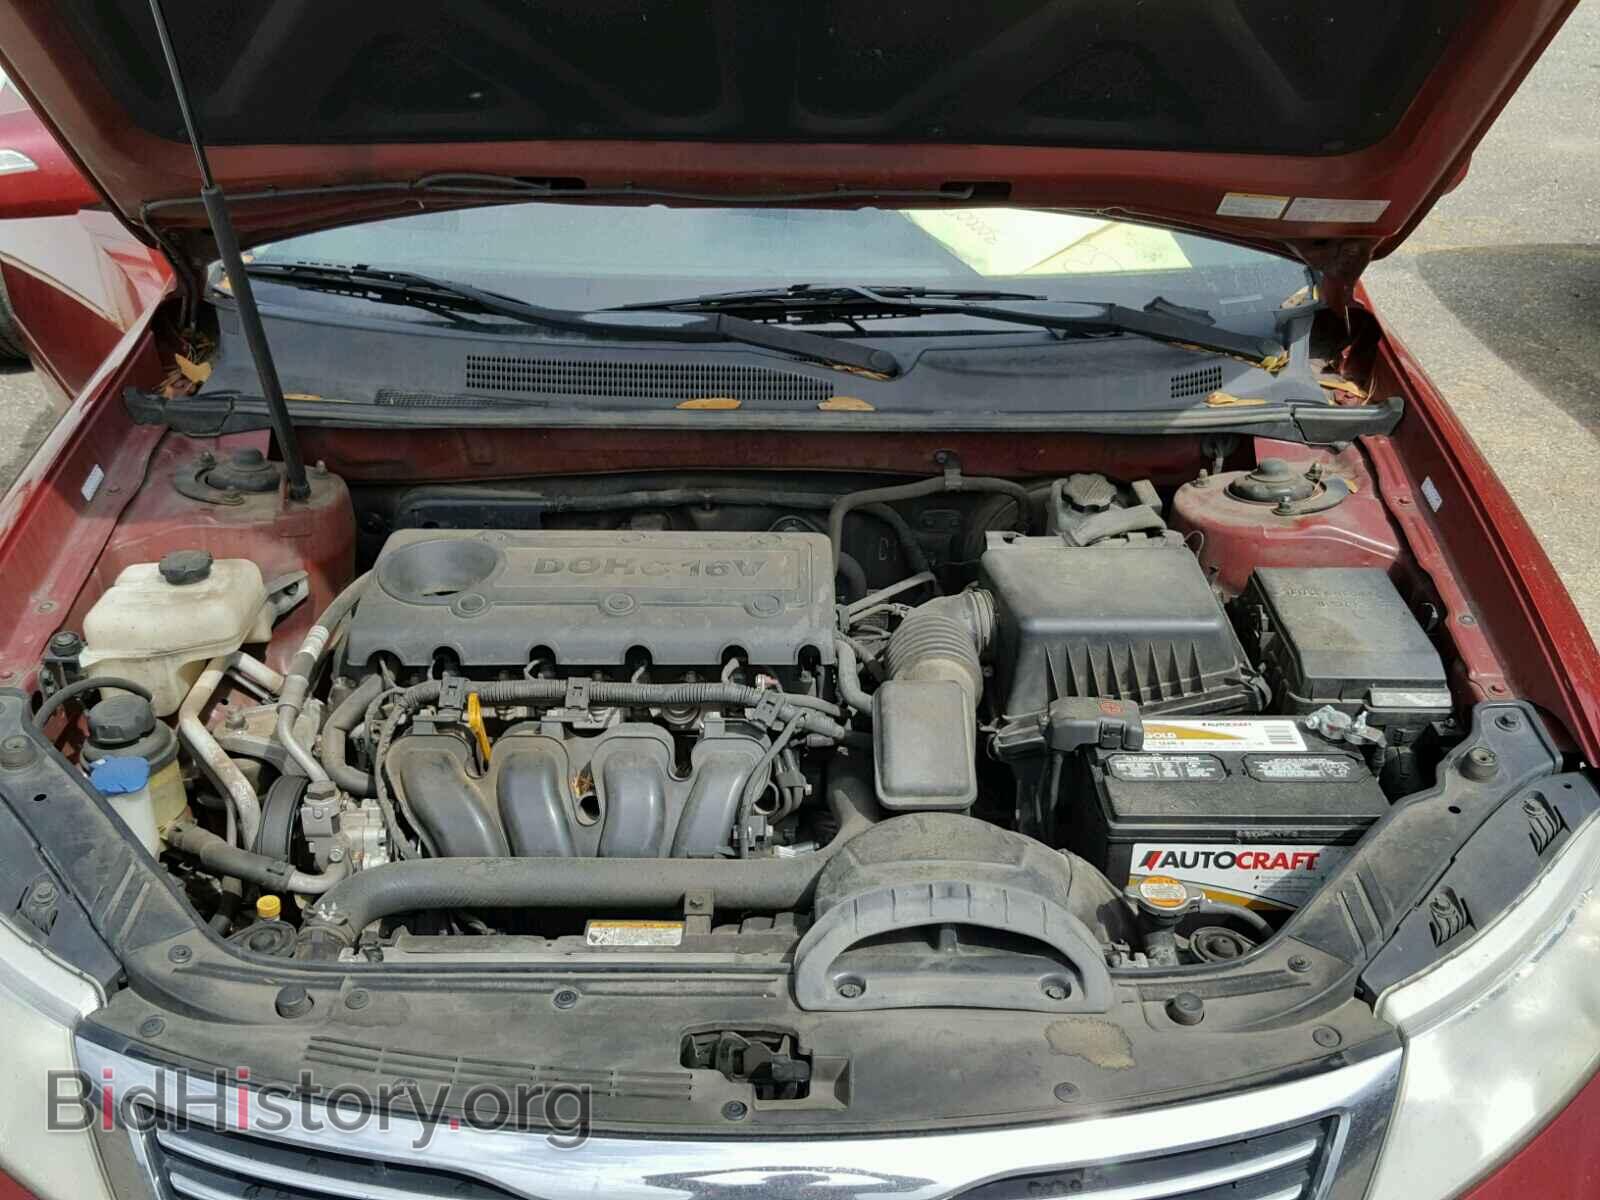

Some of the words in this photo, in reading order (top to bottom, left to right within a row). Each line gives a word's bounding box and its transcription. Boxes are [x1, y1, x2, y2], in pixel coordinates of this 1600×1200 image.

[534, 557, 671, 577] DOHC
[681, 559, 768, 577] 16V
[1159, 850, 1320, 870] AUTOCRAFT
